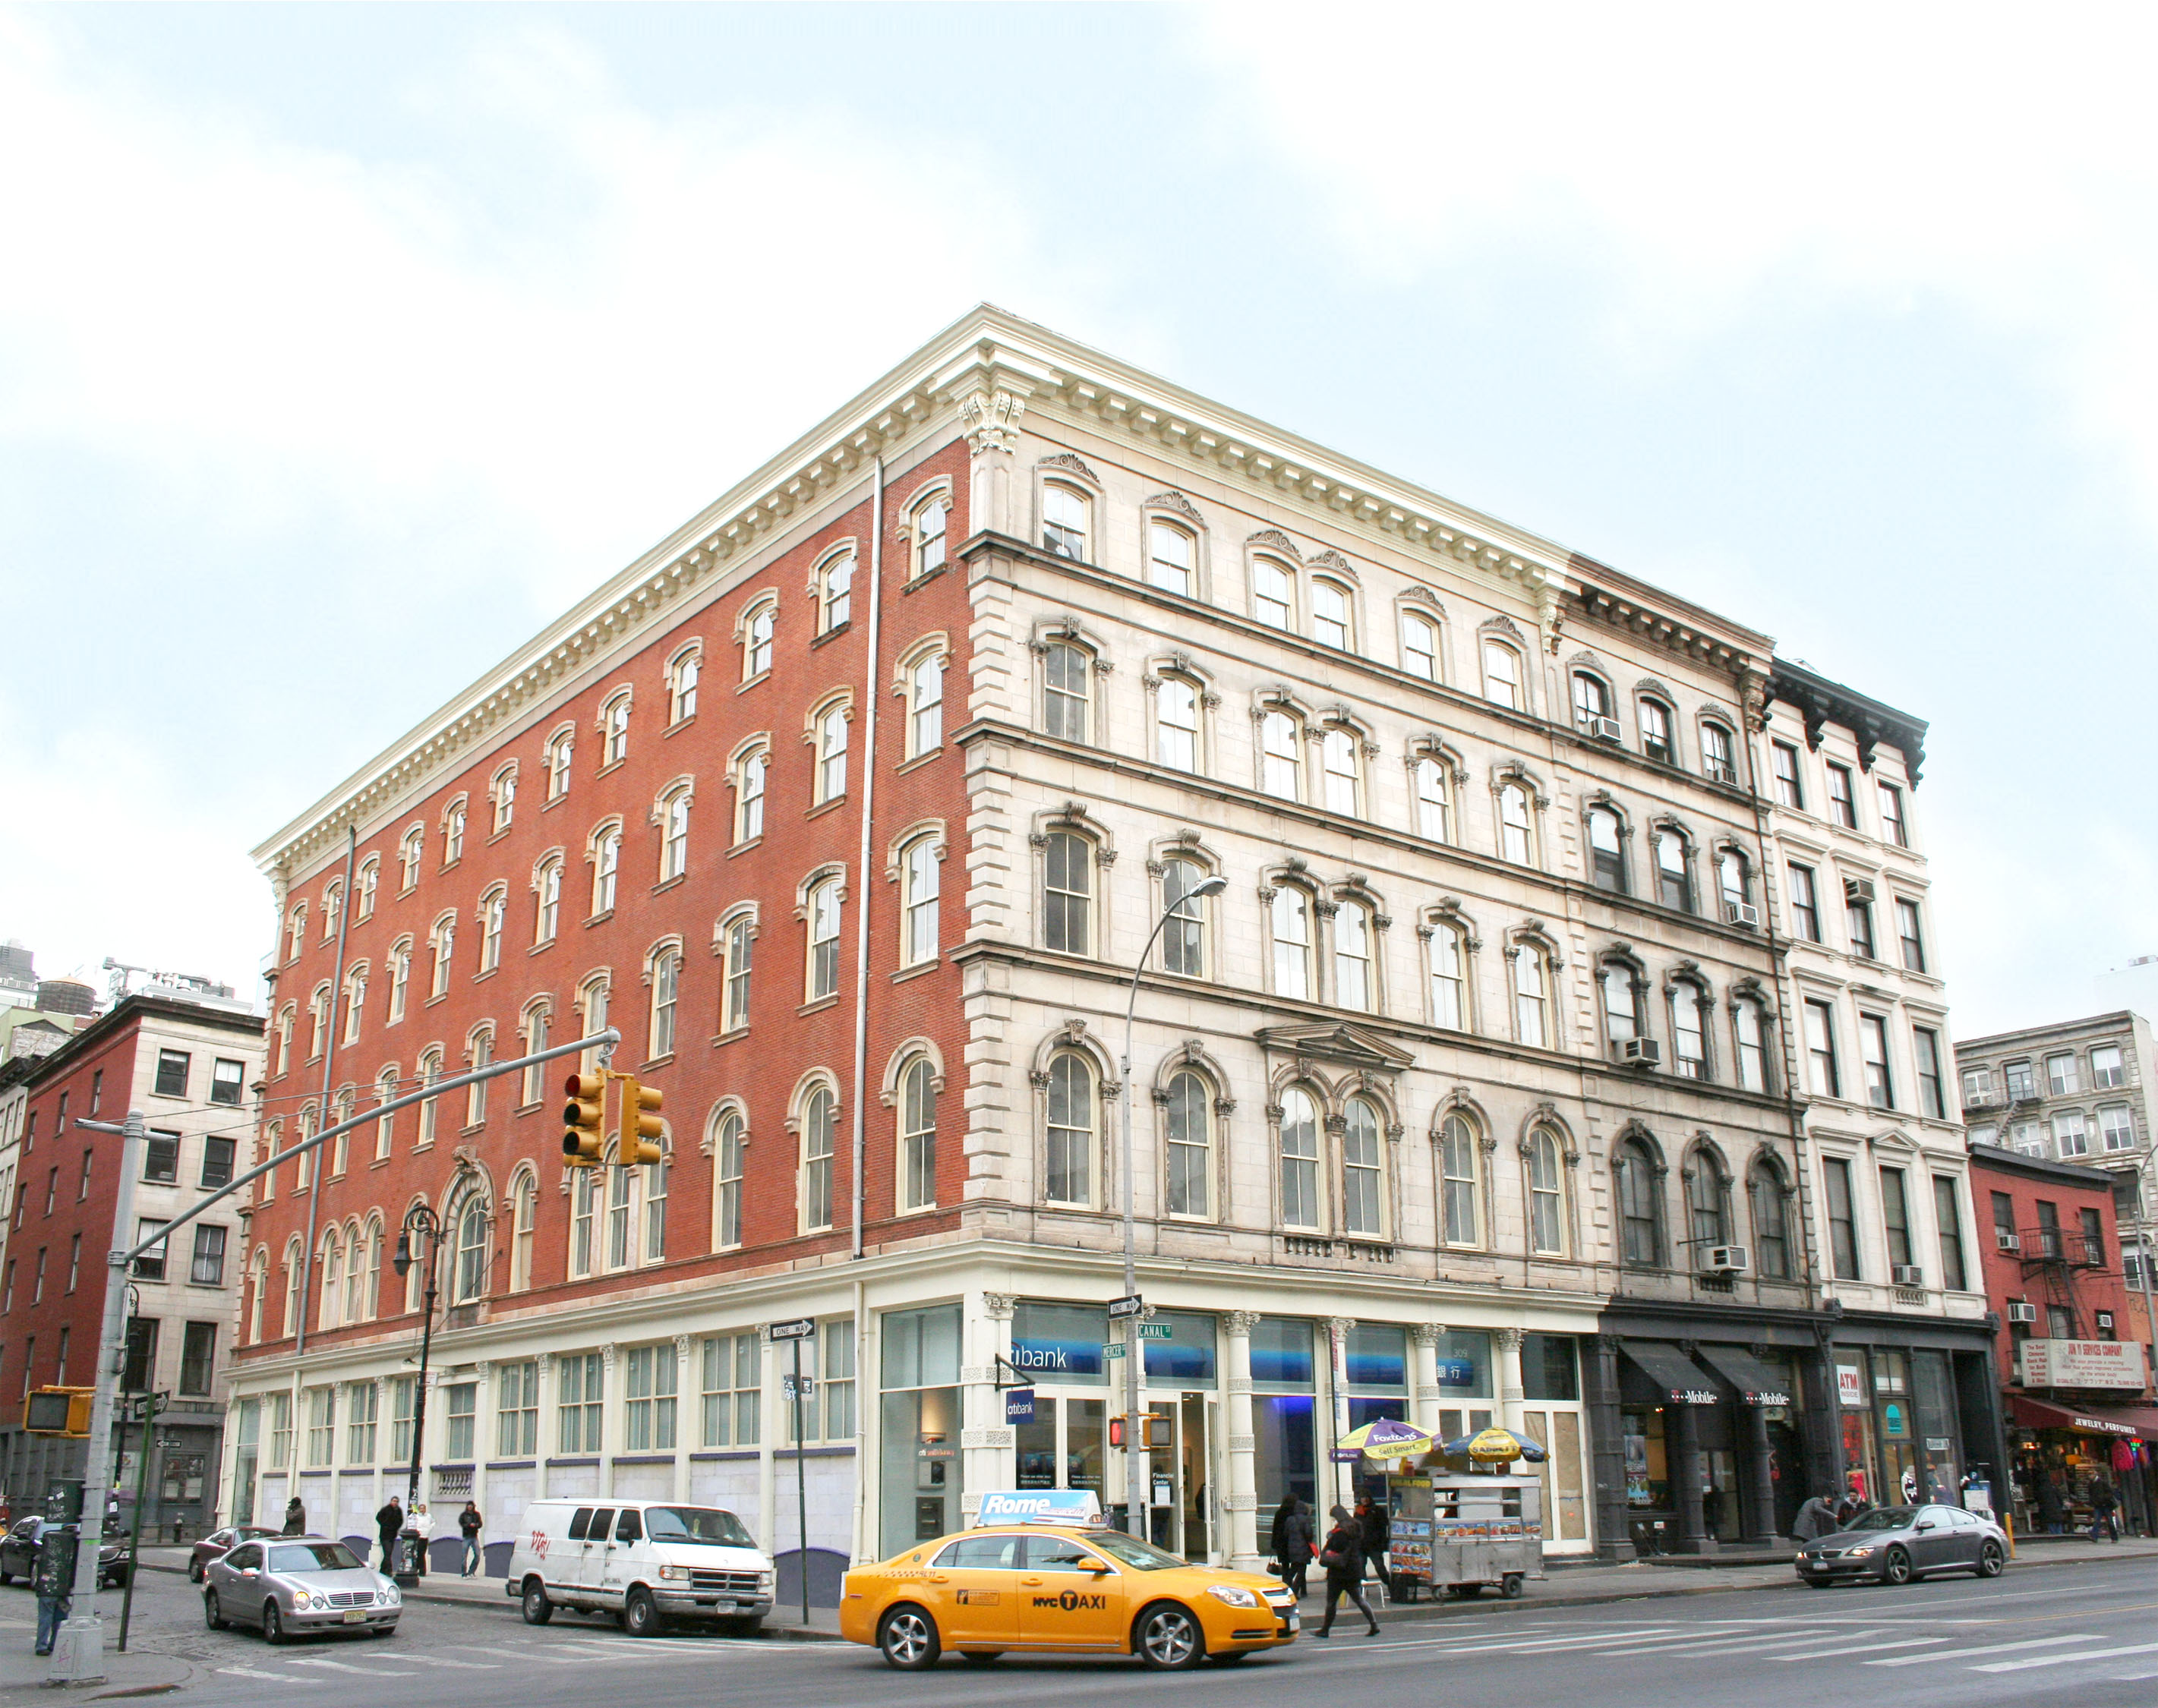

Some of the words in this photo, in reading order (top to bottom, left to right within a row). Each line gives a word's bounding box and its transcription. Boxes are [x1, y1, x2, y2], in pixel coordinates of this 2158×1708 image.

[1112, 1304, 1122, 1313] ONE
[1126, 1301, 1136, 1311] WAY
[776, 1327, 790, 1336] ONE
[796, 1324, 808, 1333] WAY
[1139, 1325, 1165, 1338] CANAL
[1103, 1345, 1122, 1358] MERCER
[1453, 1348, 1468, 1357] 309
[2083, 1344, 2101, 1356] SERVICES
[2102, 1344, 2122, 1357] COMPANY
[1840, 1372, 1858, 1390] ATM
[1008, 1401, 1033, 1415] citibank
[2074, 1417, 2102, 1428] JEWELRY
[2105, 1422, 2136, 1434] PERFUMES
[985, 1495, 1050, 1514] Rome
[1033, 1596, 1058, 1608] NYC
[1059, 1590, 1106, 1611] TAXI
